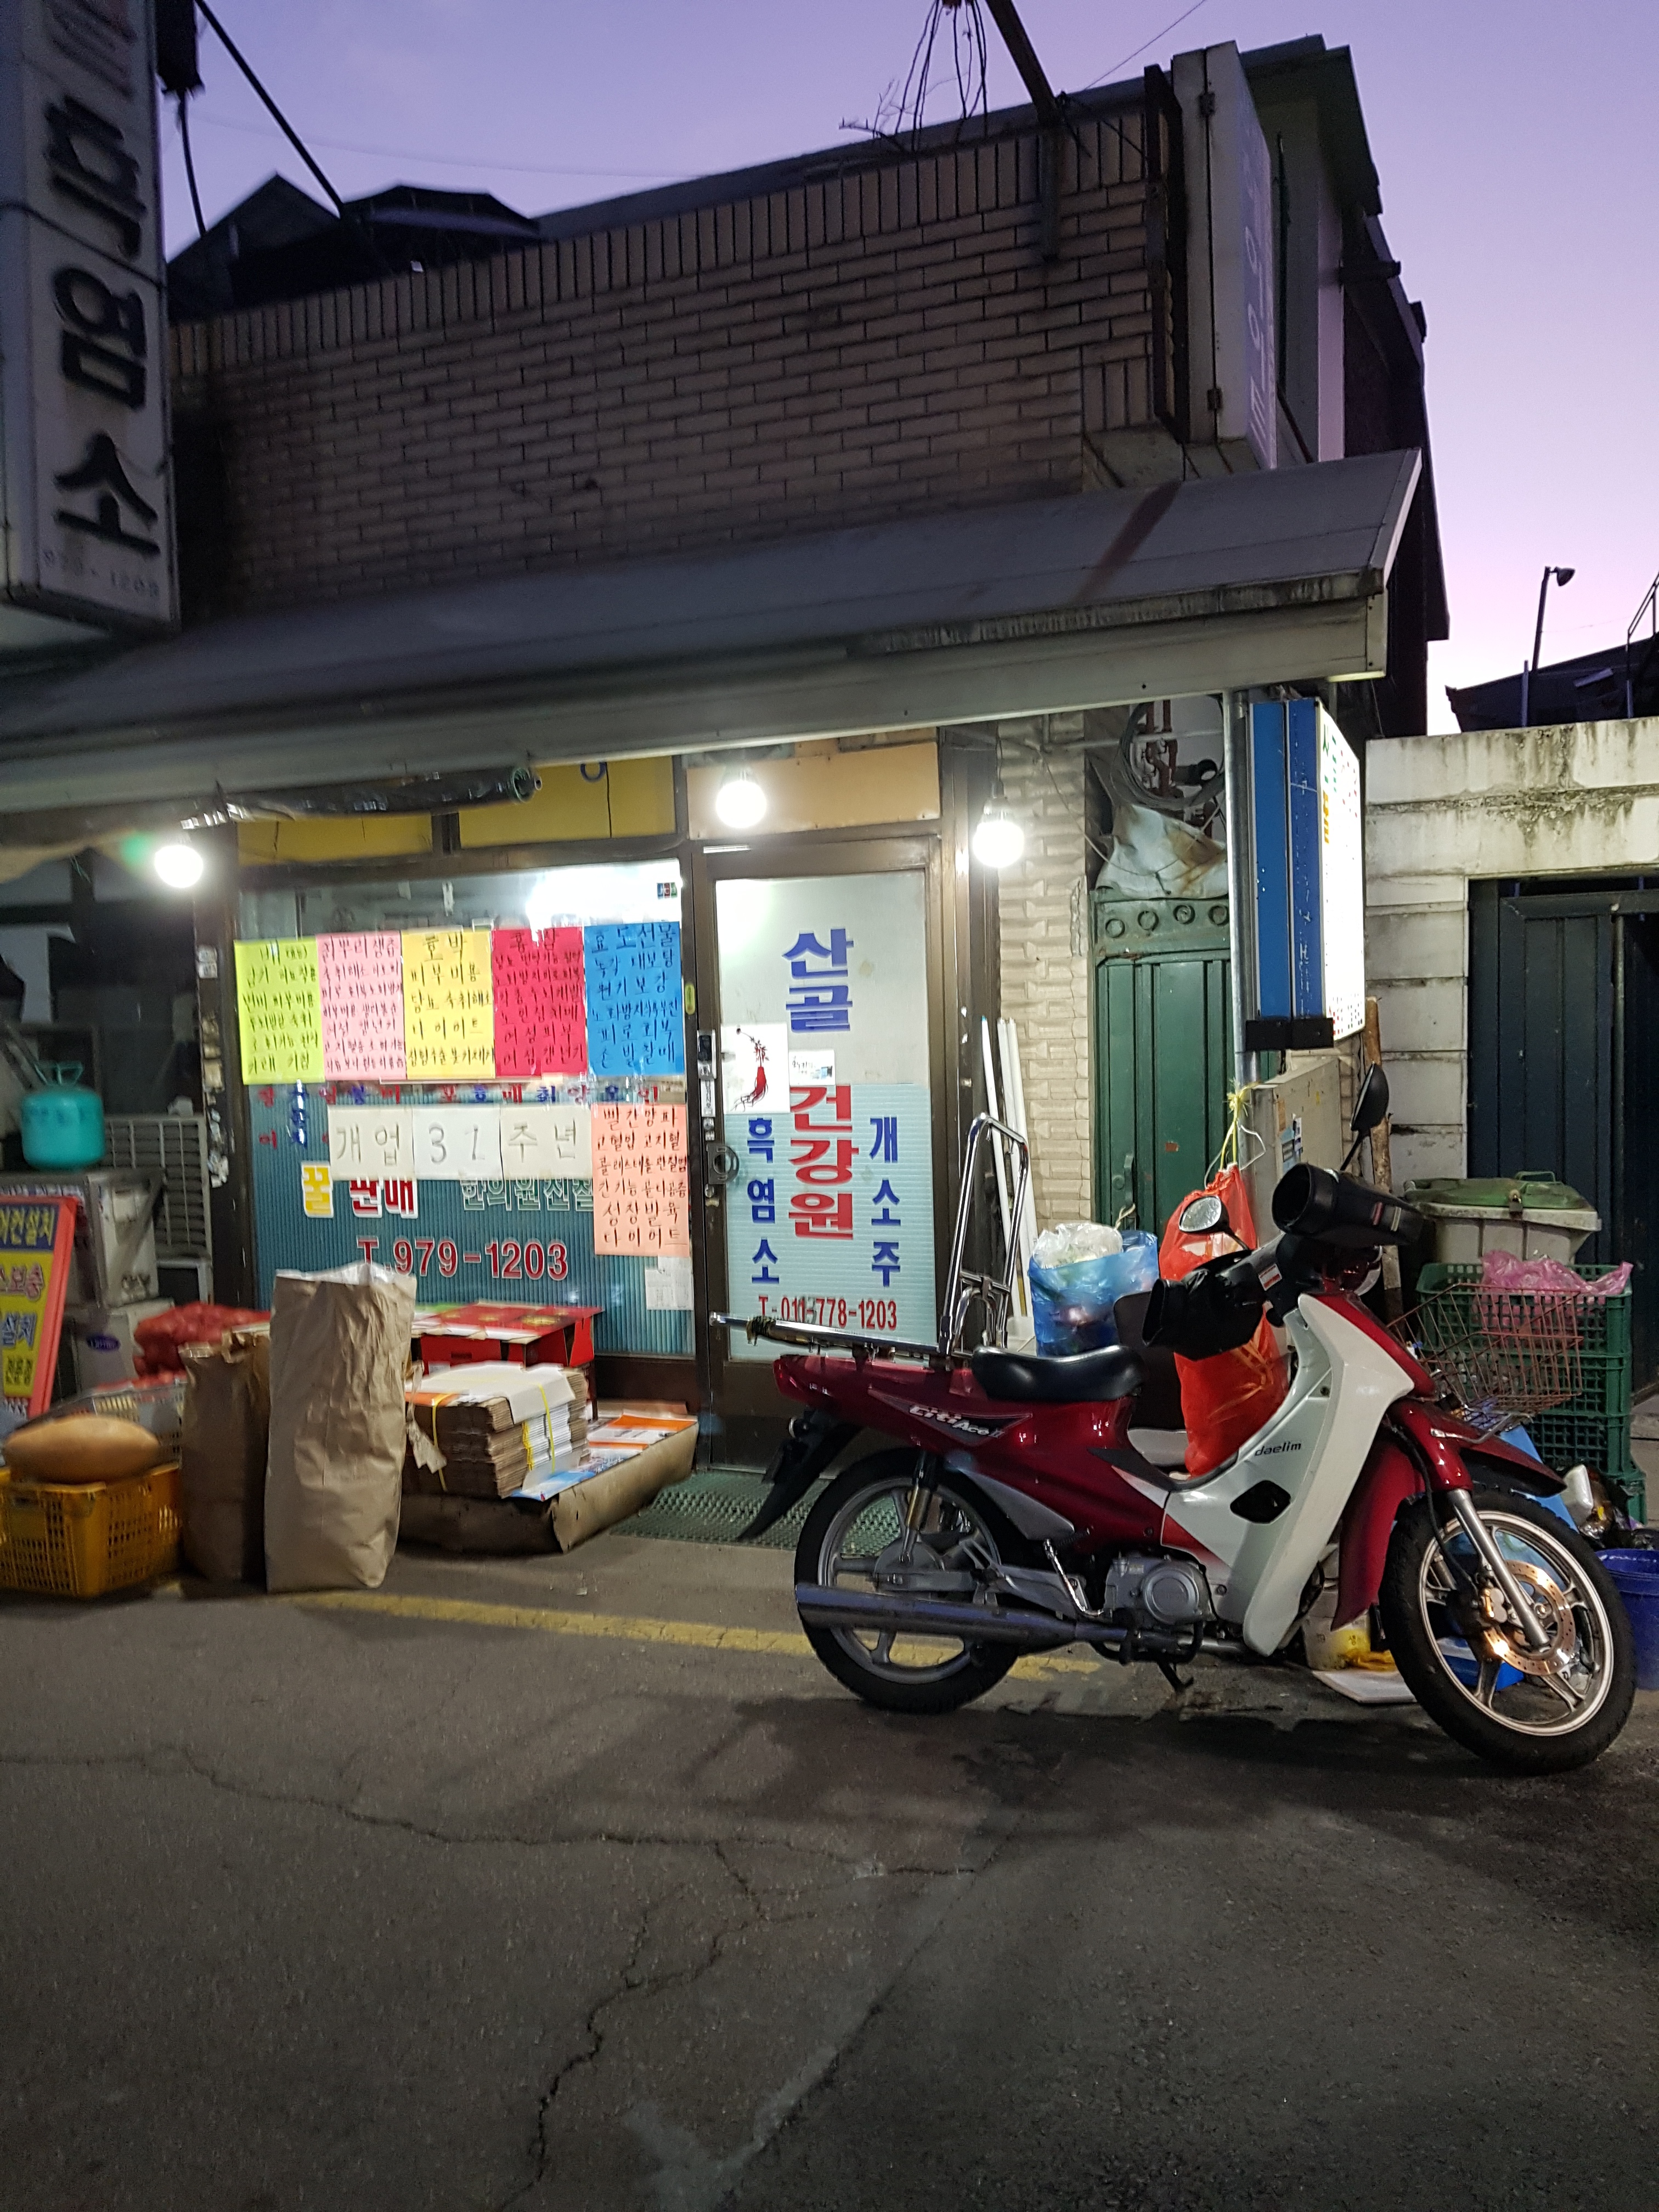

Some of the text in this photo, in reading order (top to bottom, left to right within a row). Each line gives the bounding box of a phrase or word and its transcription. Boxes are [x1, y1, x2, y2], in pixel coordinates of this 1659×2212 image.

[423, 930, 467, 962] 호박
[782, 928, 854, 1033] 산골
[444, 989, 493, 1009] 숙취해소
[413, 1016, 483, 1040] 다이어트
[788, 1085, 859, 1239] 건강원
[747, 1116, 780, 1284] 흑염소
[869, 1116, 901, 1287] 개소주
[604, 1225, 688, 1249] 다이어트
[1254, 1441, 1302, 1457] daelim
